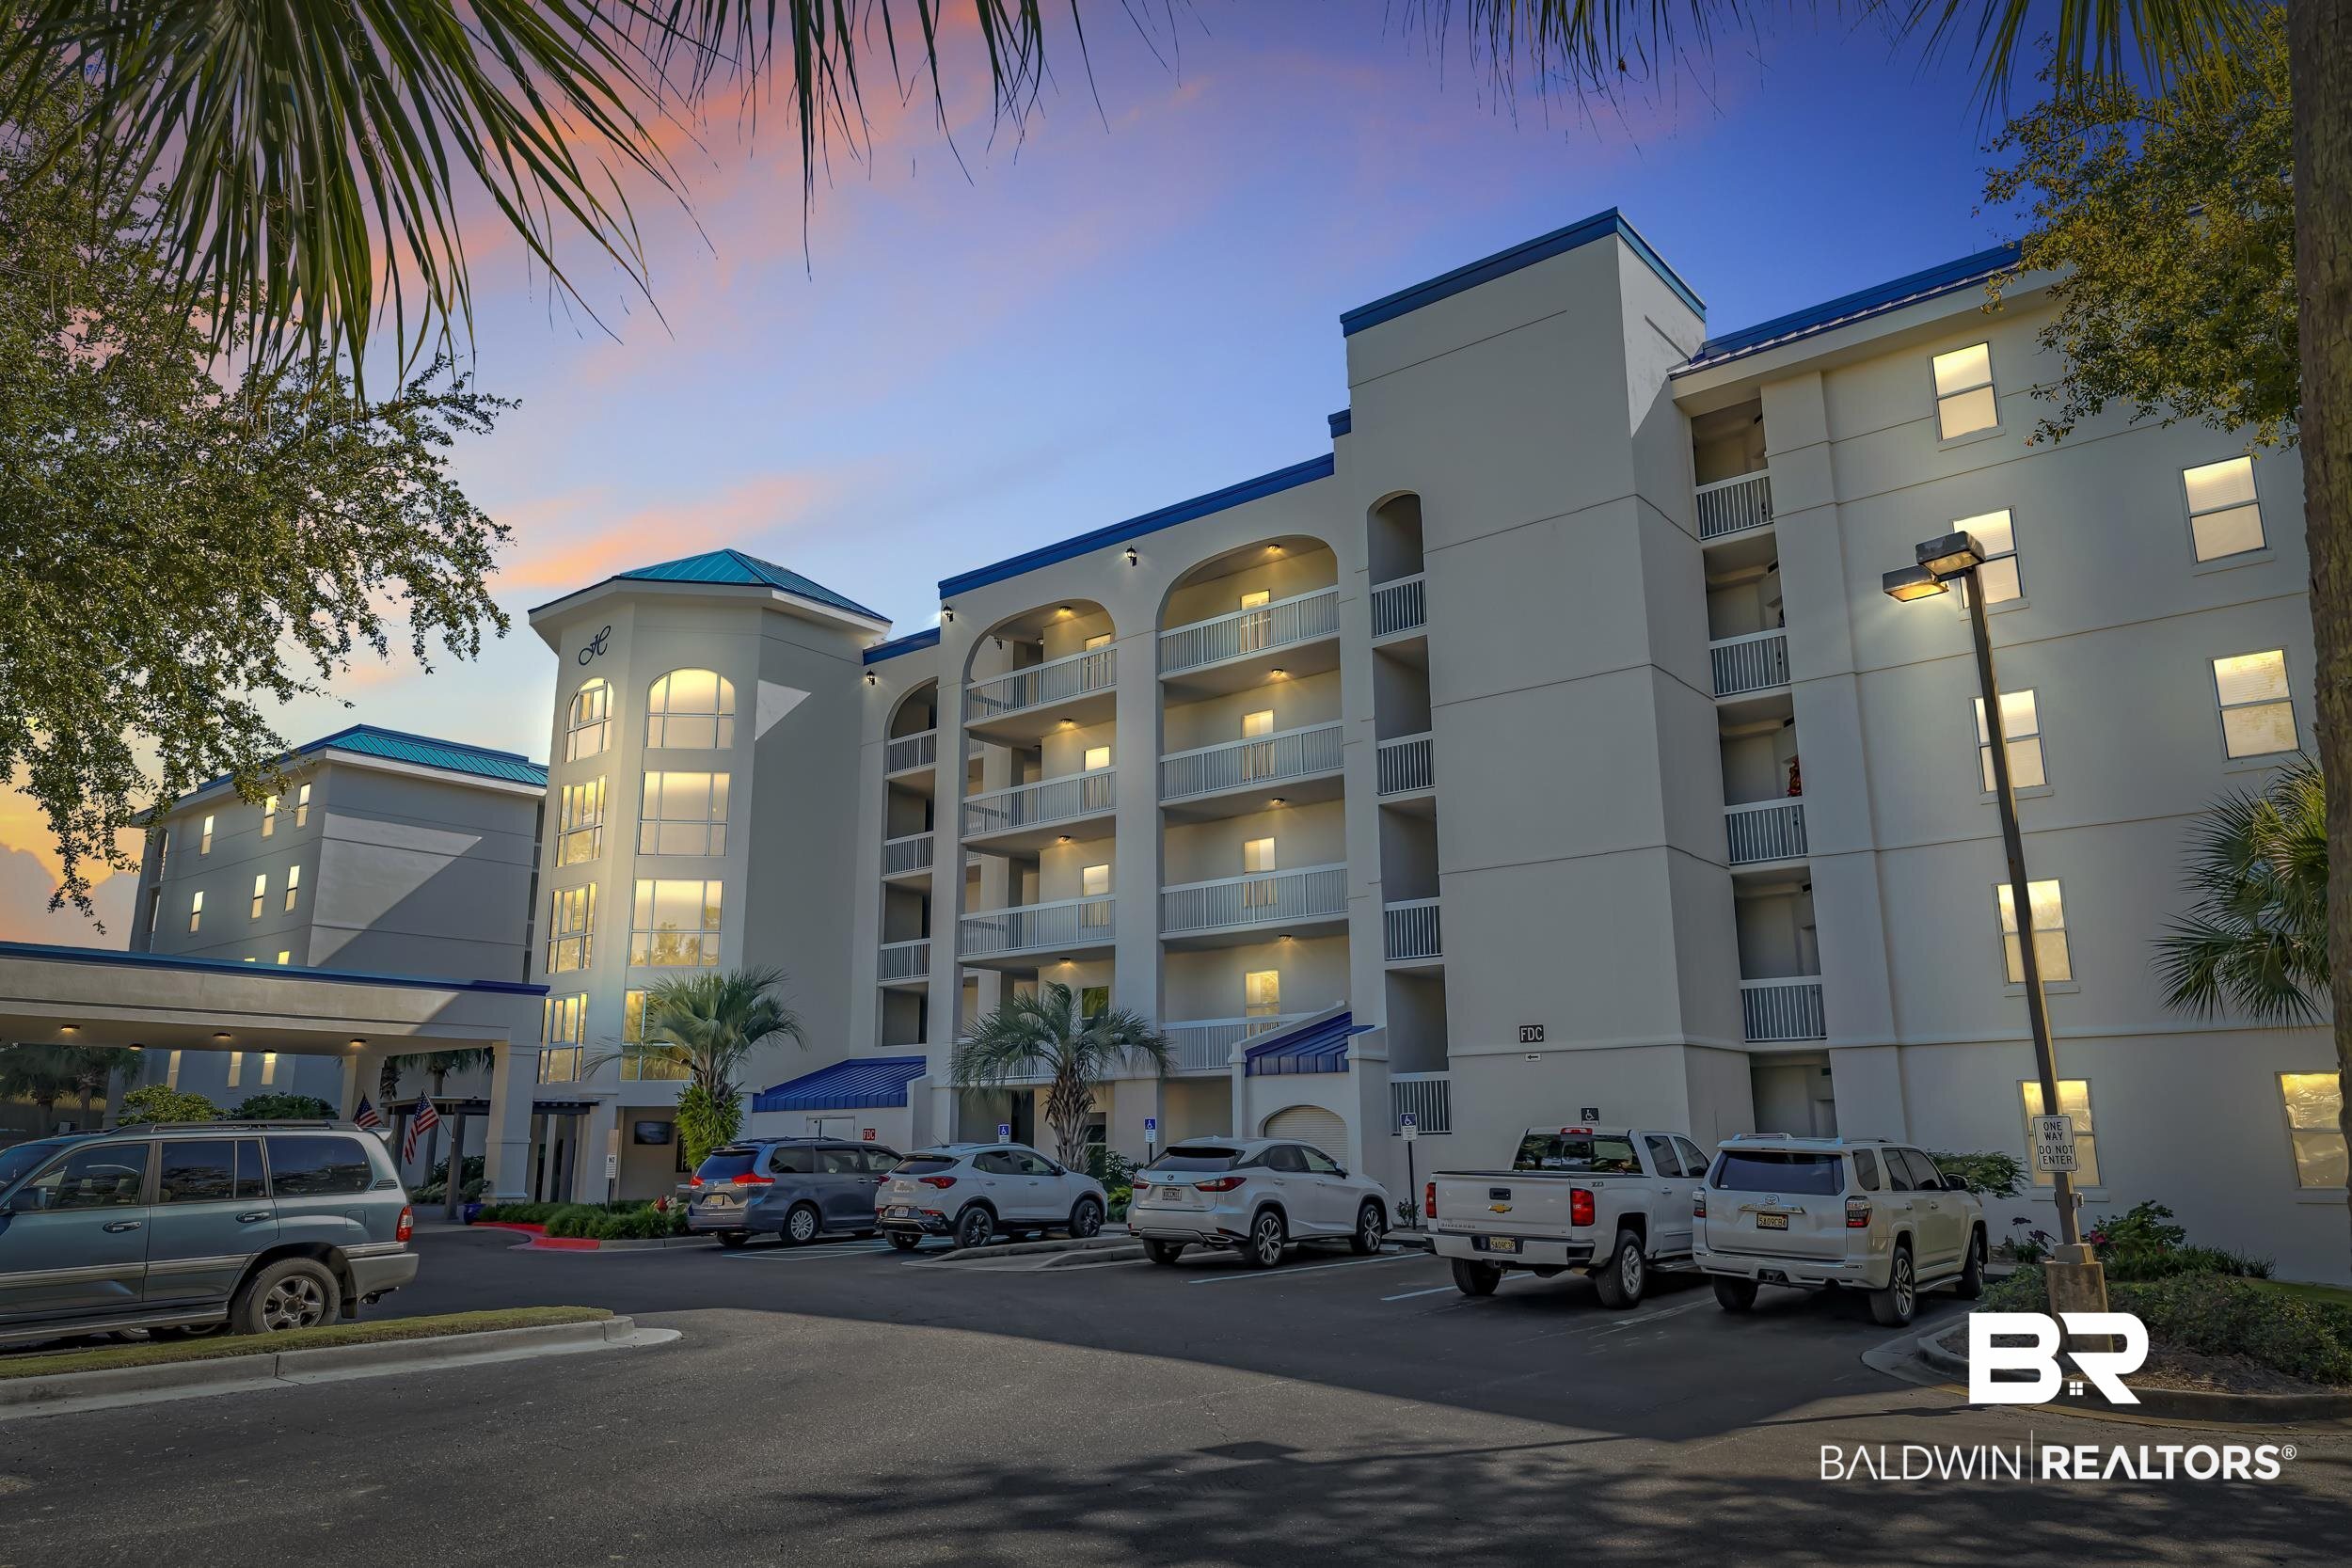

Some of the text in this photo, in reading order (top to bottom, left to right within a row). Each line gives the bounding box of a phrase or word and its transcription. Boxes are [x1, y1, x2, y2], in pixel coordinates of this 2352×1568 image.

[1520, 1026, 1542, 1041] FDC
[2042, 1121, 2062, 1131] ONE
[863, 1130, 875, 1140] FDC
[2044, 1132, 2062, 1141] WAY
[2039, 1145, 2074, 1154] DO NOT
[2042, 1155, 2073, 1164] ENTER
